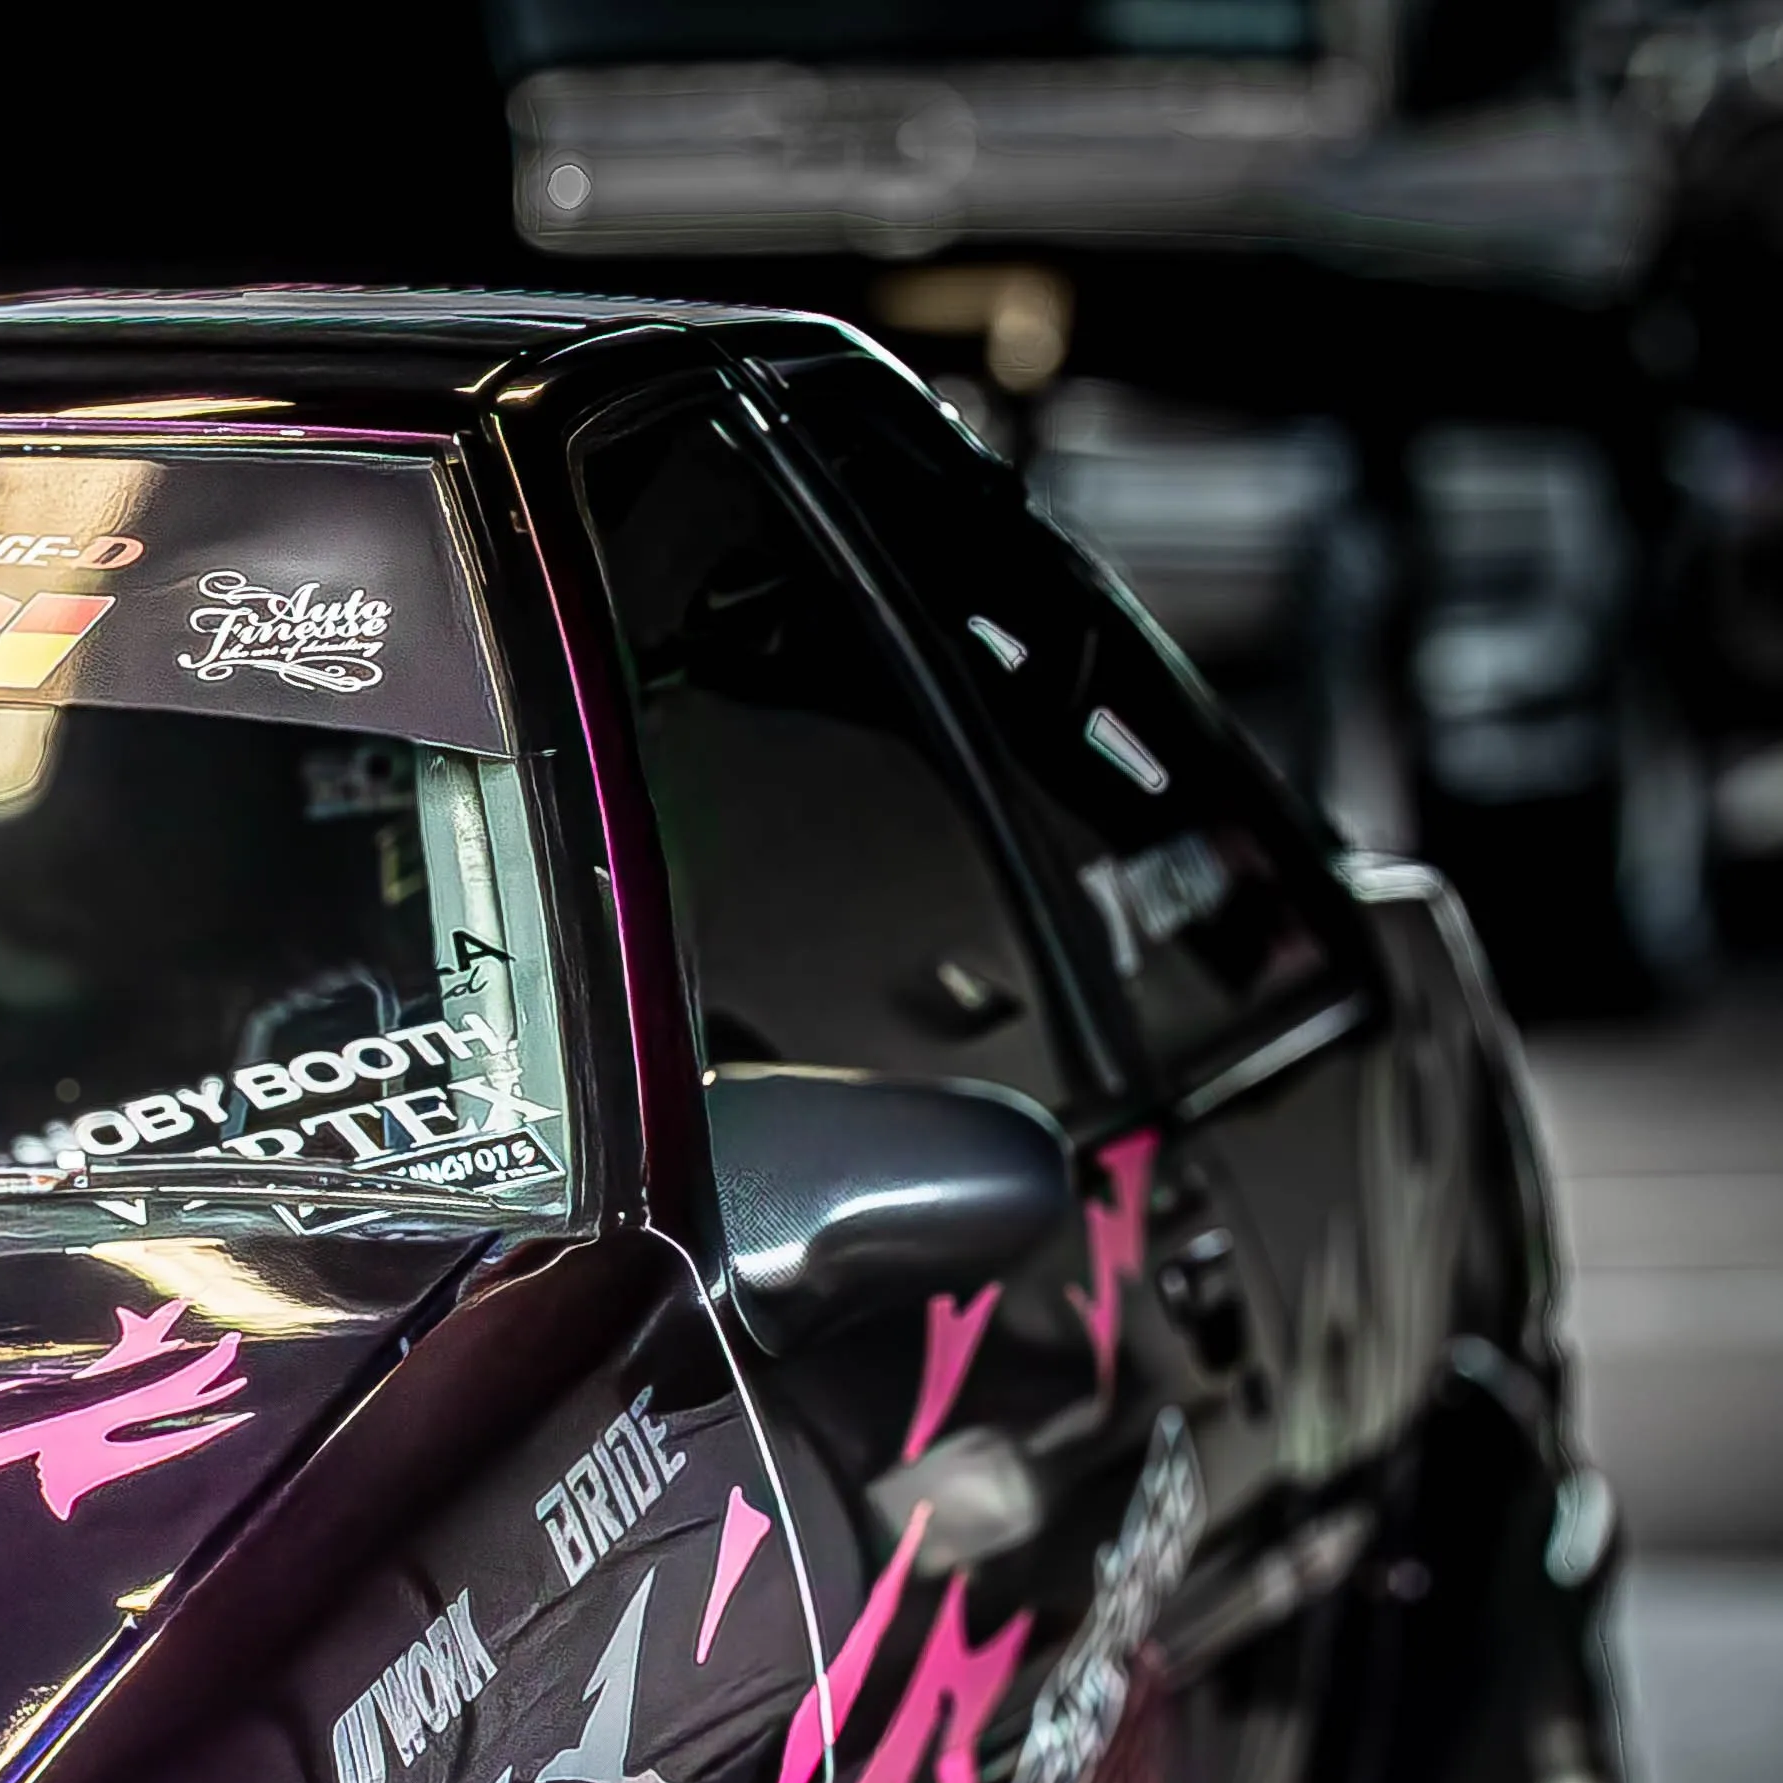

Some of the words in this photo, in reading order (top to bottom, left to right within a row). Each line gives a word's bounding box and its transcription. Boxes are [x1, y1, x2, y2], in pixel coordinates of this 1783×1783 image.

[177, 606, 389, 669] Finesse
[266, 580, 393, 625] Auto
[234, 1013, 504, 1111] BOOTH
[534, 1384, 688, 1588] BRIDE
[369, 1587, 501, 1769] WORK
